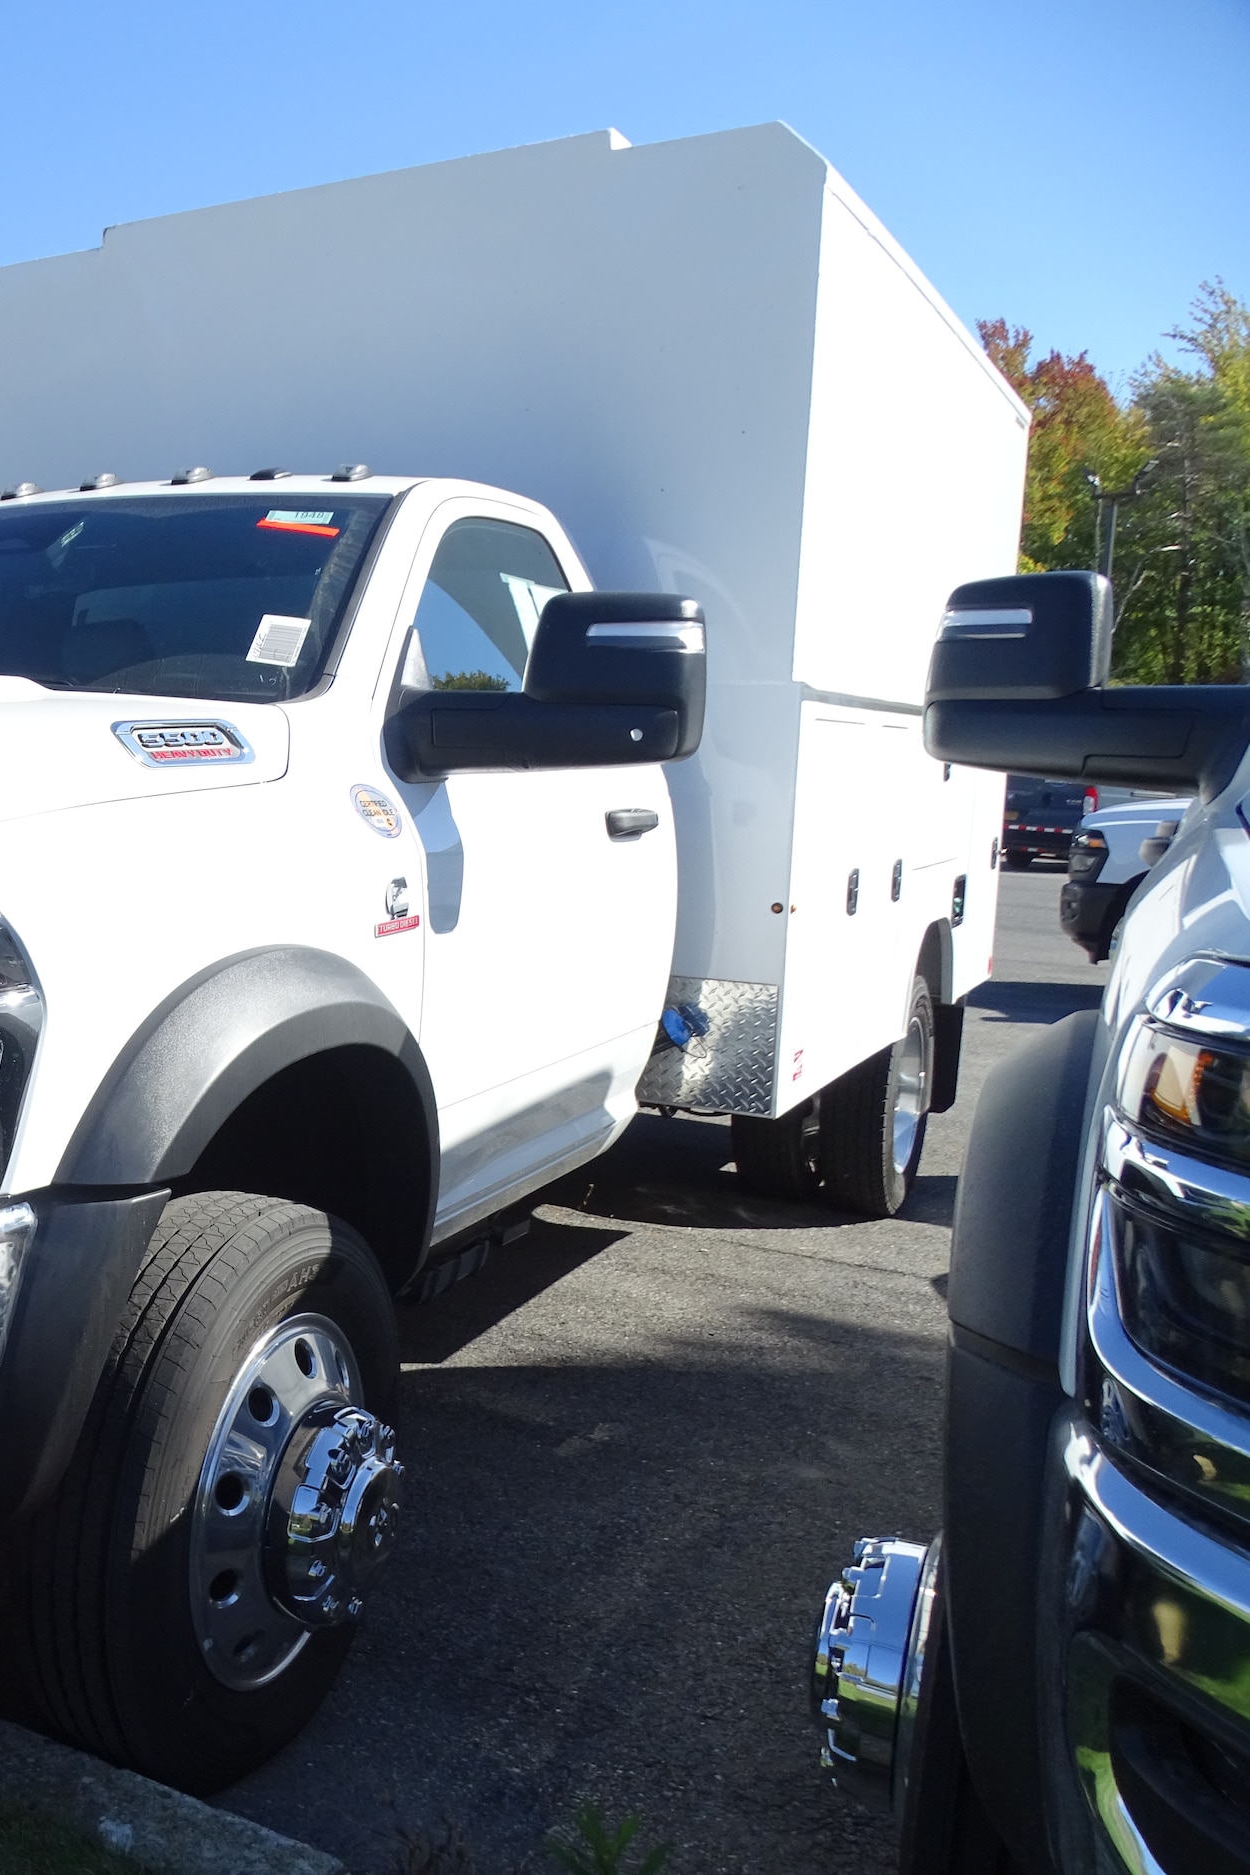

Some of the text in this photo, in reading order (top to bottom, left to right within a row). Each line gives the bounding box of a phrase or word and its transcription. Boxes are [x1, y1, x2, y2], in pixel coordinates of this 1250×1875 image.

[294, 511, 325, 519] 1948
[138, 730, 225, 748] 5500
[151, 747, 233, 760] HEAVY DUTY
[381, 808, 396, 816] IDLE
[378, 916, 419, 933] TURBO DIESEL
